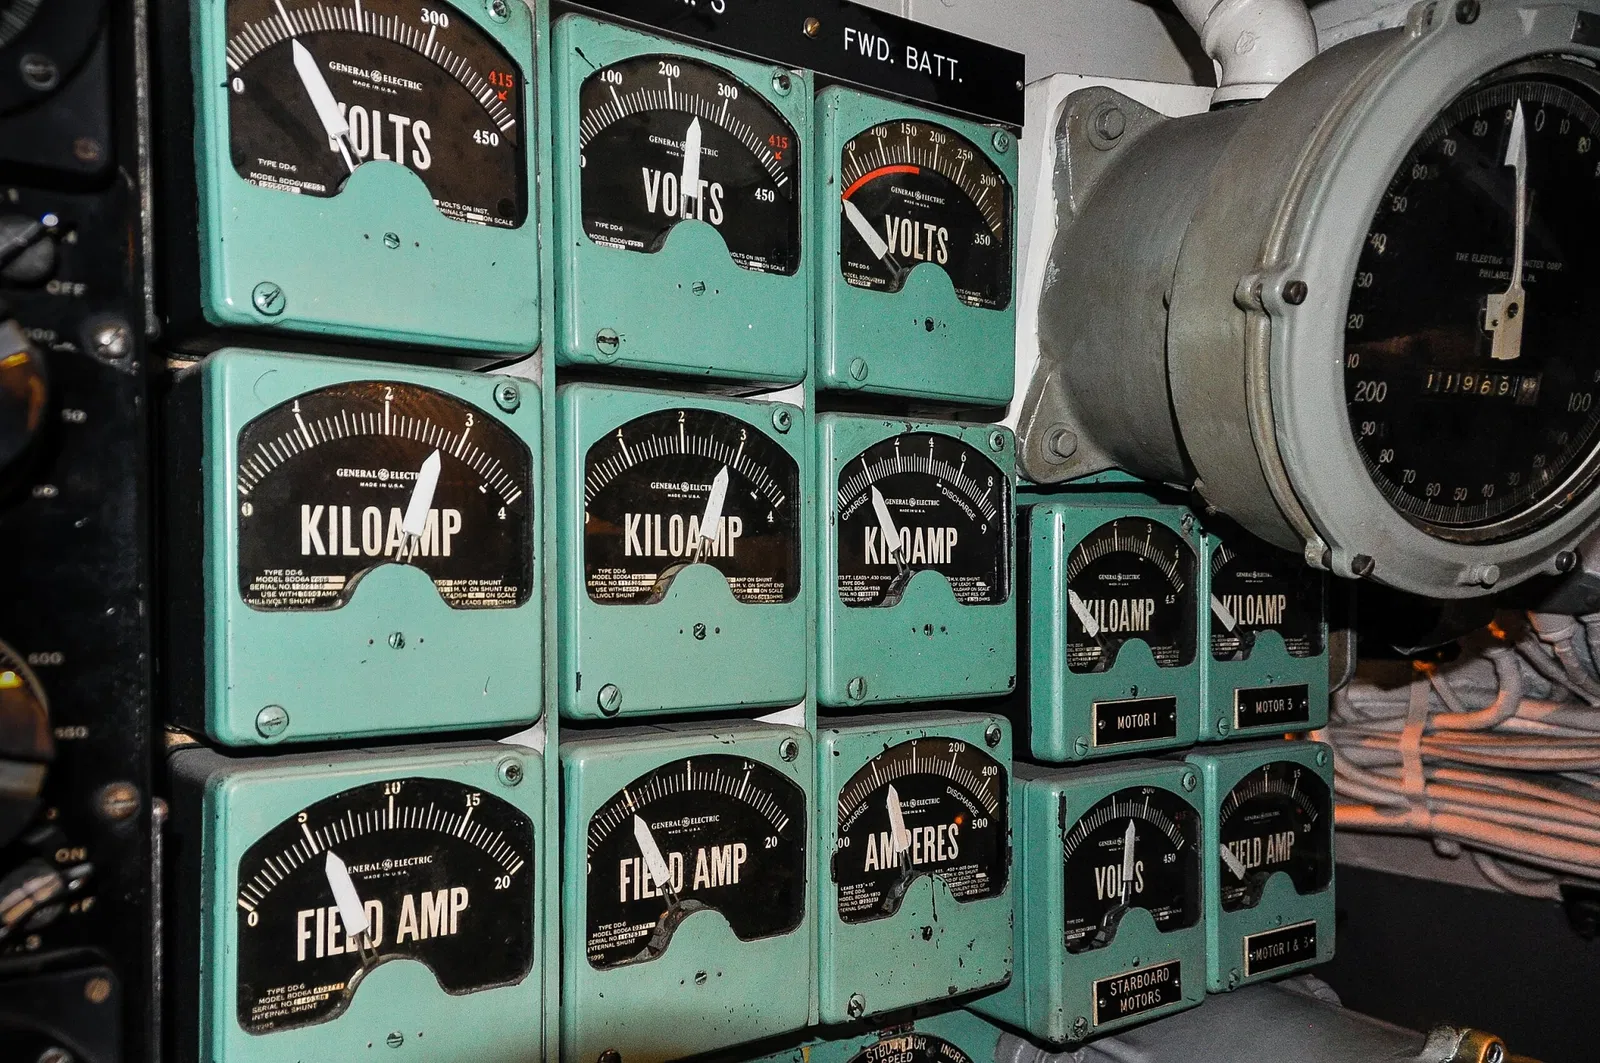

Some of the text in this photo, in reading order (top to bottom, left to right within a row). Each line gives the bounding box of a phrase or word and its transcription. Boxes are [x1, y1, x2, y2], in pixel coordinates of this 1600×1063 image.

[421, 8, 448, 28] 300
[844, 27, 963, 83] FWD. BATT.
[329, 61, 423, 91] GENERAL ELECTRIC
[601, 70, 623, 85] 100
[658, 62, 680, 78] 200
[232, 78, 245, 93] 0
[488, 71, 513, 88] 415
[718, 83, 738, 100] 300
[1473, 120, 1488, 137] 80
[1535, 110, 1545, 132] 0
[1560, 119, 1570, 135] 10
[901, 123, 917, 137] 150
[473, 130, 499, 146] 450
[649, 135, 680, 149] GENERAL
[769, 134, 789, 149] 415
[930, 131, 946, 145] 200
[957, 148, 973, 162] 250
[1444, 140, 1457, 157] 70
[258, 158, 277, 168] TYPE
[250, 172, 278, 183] MODEL
[1412, 164, 1428, 181] 60
[980, 174, 997, 187] 300
[754, 188, 775, 203] 450
[891, 186, 946, 205] GENERAL ELECTRIC
[441, 201, 461, 210] VOLTS
[1392, 197, 1408, 213] 50
[494, 218, 514, 226] SCALE
[595, 222, 609, 230] TYPE
[885, 214, 949, 265] VOLTS
[974, 233, 991, 247] 350
[1358, 272, 1373, 288] 30
[1349, 314, 1364, 330] 20
[1348, 353, 1360, 369] 10
[384, 387, 394, 401] 2
[1355, 381, 1388, 403] 200
[1568, 393, 1592, 412] 100
[465, 413, 475, 427] 3
[678, 411, 685, 423] 2
[740, 428, 748, 441] 3
[1361, 421, 1376, 436] 90
[1380, 449, 1394, 463] 80
[336, 468, 378, 479] GENERAL
[1403, 470, 1417, 484] 70
[651, 482, 681, 491] GENERAL
[1426, 483, 1441, 497] 60
[1481, 484, 1495, 498] 40
[885, 498, 909, 506] GENERAL
[1454, 488, 1468, 501] 50
[842, 493, 869, 521] CHARGE
[941, 488, 976, 521] DISCHARGE
[498, 507, 507, 520] 4
[767, 511, 774, 523] 4
[301, 504, 462, 557] KILOAMP
[625, 513, 743, 558] KILOAMP
[250, 583, 277, 591] SERIAL
[1255, 701, 1284, 715] MOTOR
[1117, 713, 1151, 730] MOTOR
[949, 743, 966, 753] 200
[982, 766, 998, 777] 400
[1294, 769, 1301, 778] 15
[384, 782, 401, 795] 10
[466, 793, 481, 808] 15
[917, 798, 941, 806] ELECTRIC
[946, 787, 980, 818] DISCHARGE
[652, 815, 720, 830] GENERAL ELECTRIC
[842, 802, 870, 832] CHARGE
[972, 818, 988, 830] 500
[1304, 824, 1311, 833] 20
[765, 836, 778, 849] 20
[1266, 831, 1295, 865] AMP
[55, 848, 85, 863] ON
[1163, 853, 1176, 864] 450
[348, 855, 433, 874] ENERAL ELECTRIC
[694, 843, 747, 891] AMP
[494, 876, 511, 890] 20
[1095, 861, 1144, 901] VOLS
[248, 912, 259, 927] 0
[396, 887, 469, 944] AMP
[593, 931, 613, 939] MODEL
[617, 938, 636, 947] SHUNT
[1256, 944, 1285, 961] MOTOR
[1111, 968, 1170, 997] STARBOARD
[267, 987, 286, 996] TYPE
[259, 996, 285, 1005] MODEL
[1120, 992, 1161, 1013] MOTORS
[252, 1003, 278, 1014] SERIAL
[252, 1002, 318, 1021] INTERNAL SHUNT
